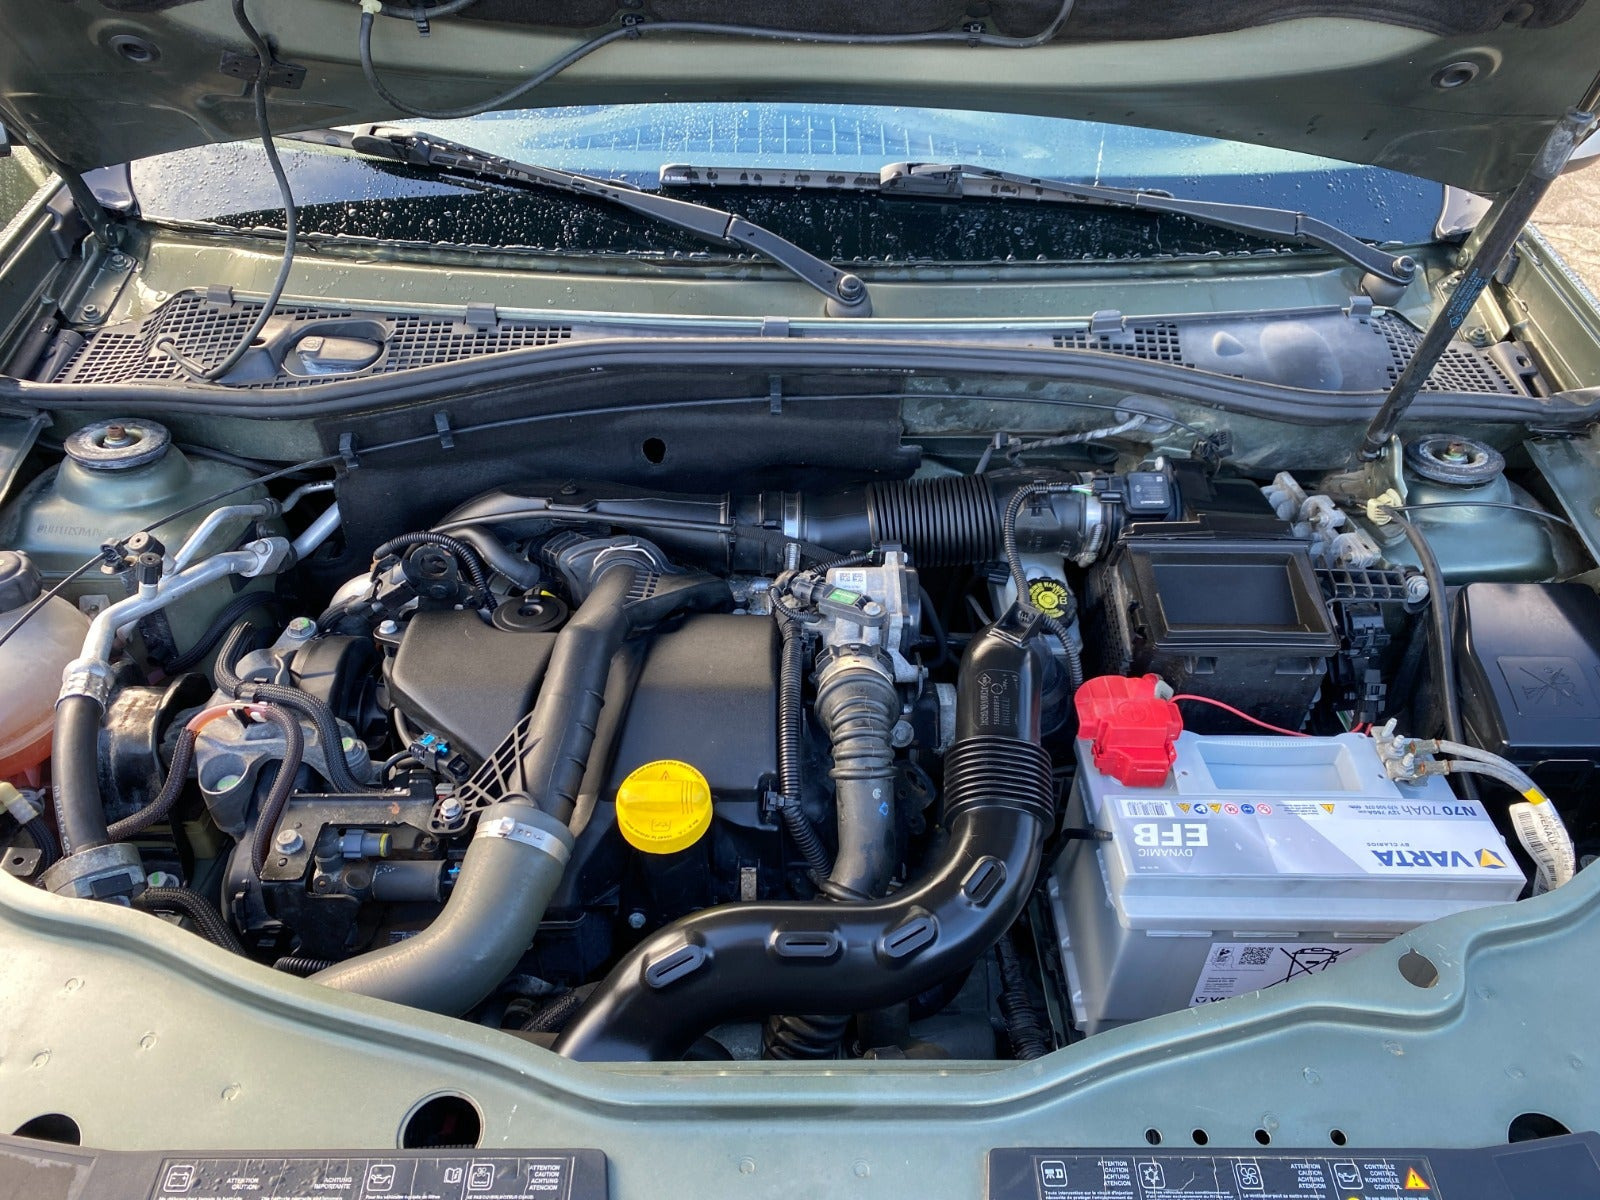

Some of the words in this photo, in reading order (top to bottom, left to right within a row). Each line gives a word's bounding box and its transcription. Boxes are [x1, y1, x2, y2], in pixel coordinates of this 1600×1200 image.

[1401, 805, 1440, 817] 70Ah
[1442, 806, 1477, 816] N70
[1133, 823, 1208, 846] EFB
[1138, 848, 1193, 857] DYNAMIC
[1371, 850, 1474, 867] VARTA
